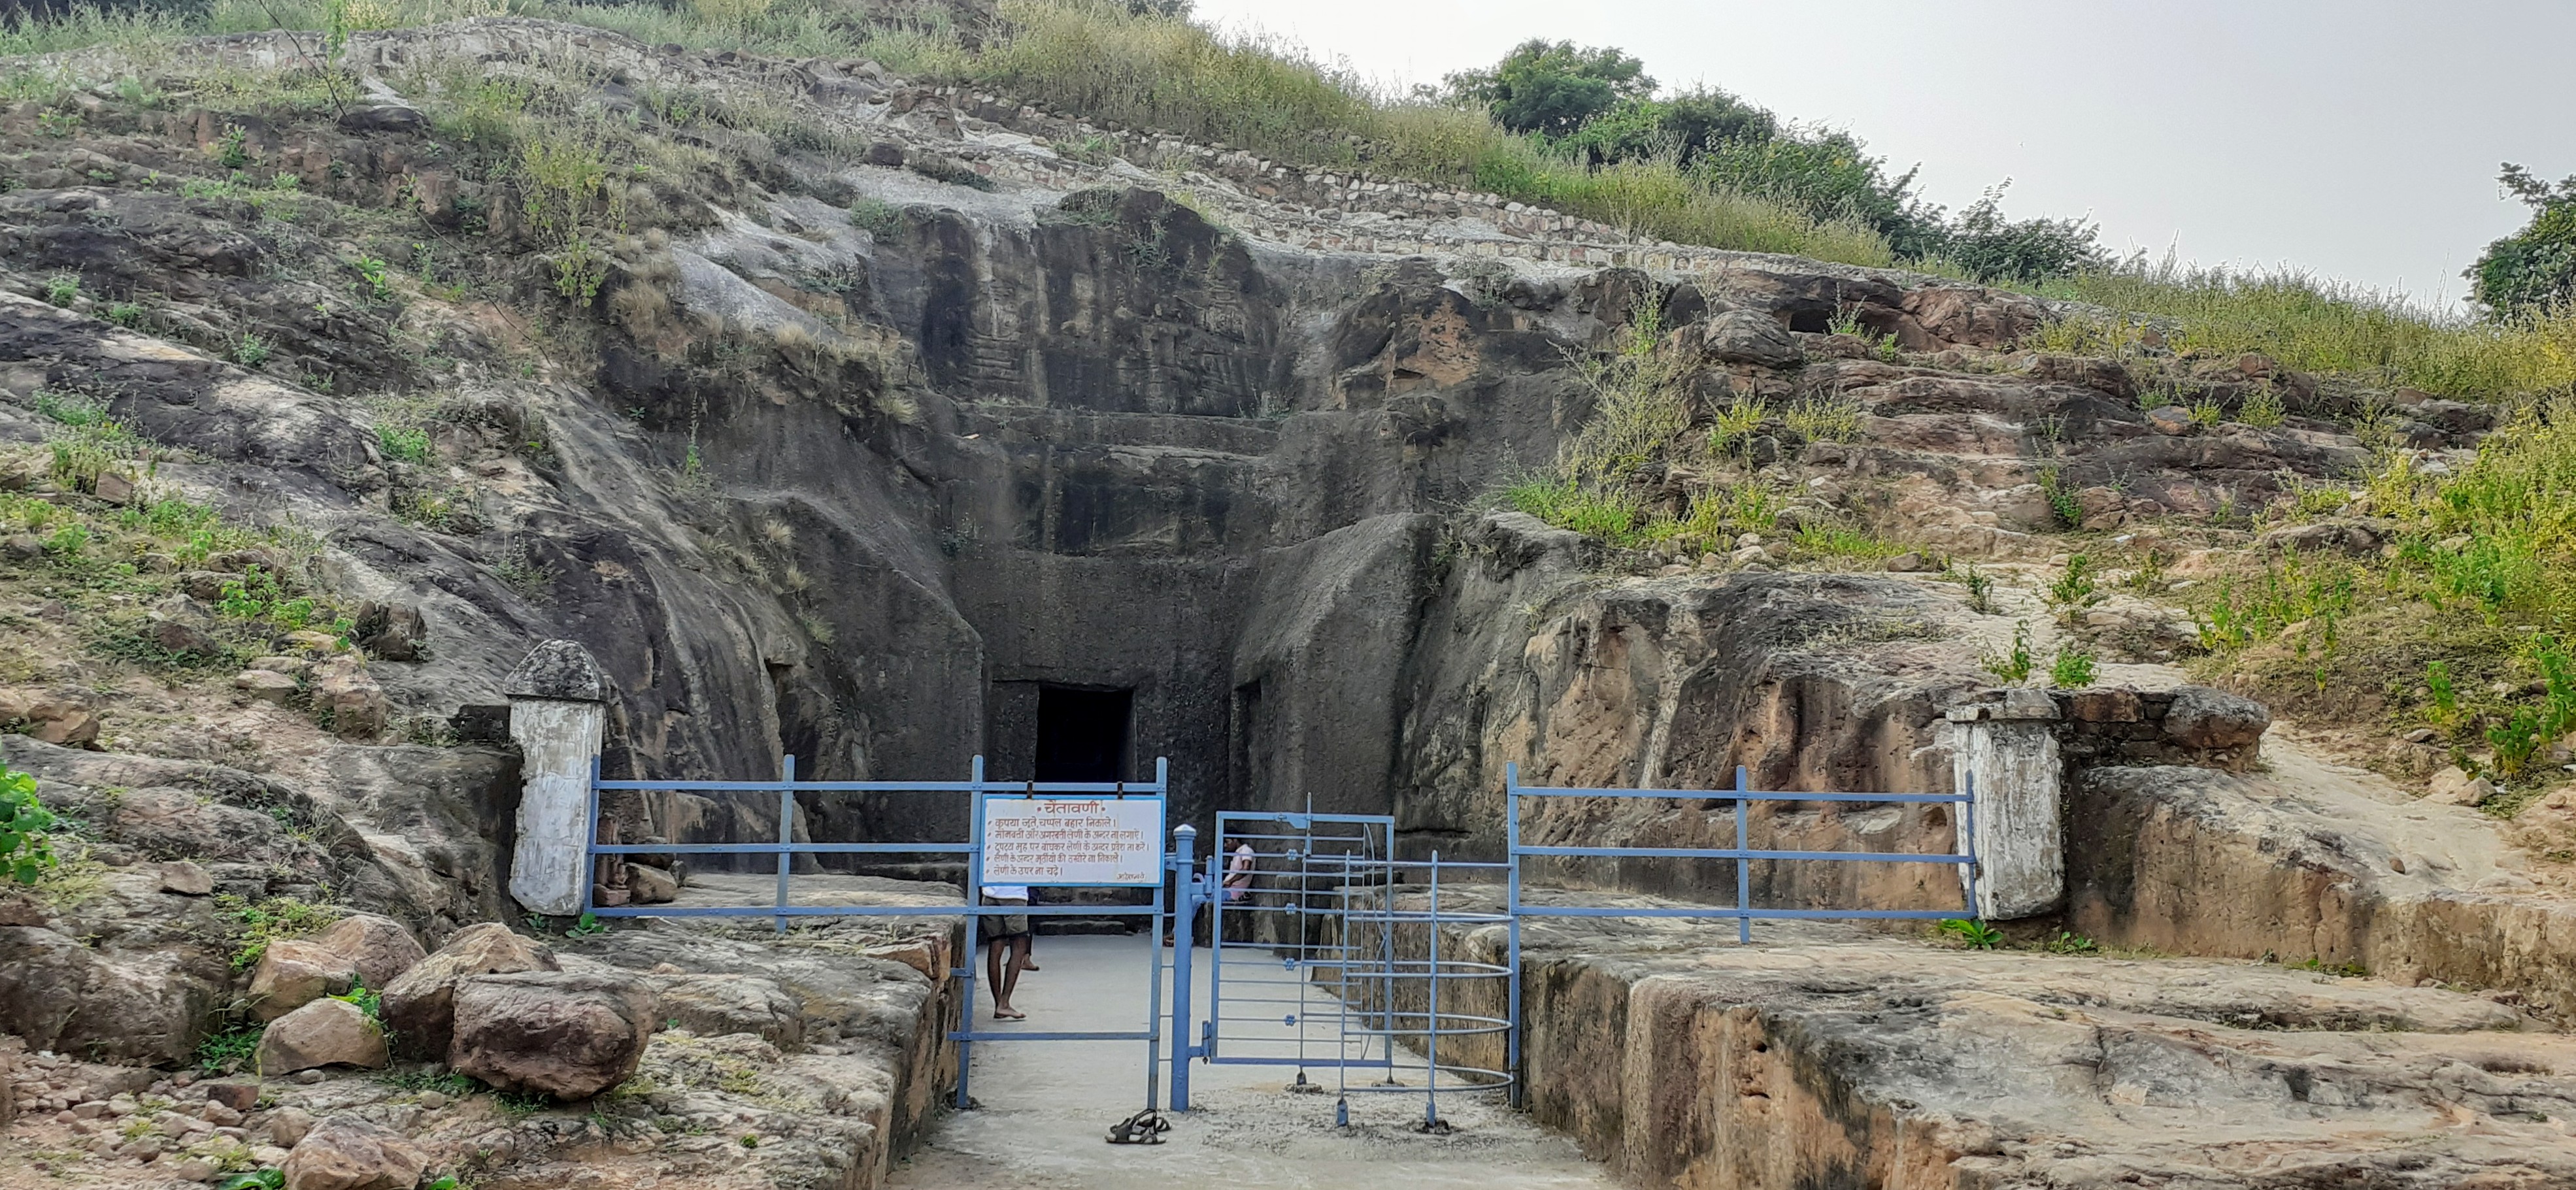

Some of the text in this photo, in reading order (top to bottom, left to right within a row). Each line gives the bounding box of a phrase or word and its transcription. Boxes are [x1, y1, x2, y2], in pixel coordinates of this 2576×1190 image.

[995, 818, 1020, 830] कृपया
[1064, 818, 1084, 828] बहार
[1067, 829, 1083, 839] लेणी
[1084, 829, 1091, 839] के
[1092, 831, 1110, 840] अन्दर
[1111, 831, 1118, 839] ना
[1029, 842, 1040, 851] पर
[1066, 840, 1082, 851] लेणी
[1083, 840, 1090, 851] के
[1092, 843, 1110, 851] अन्दर
[994, 852, 1009, 863] लेणी
[1009, 852, 1016, 862] के
[1057, 853, 1066, 863] की
[994, 865, 1009, 876] लेणी
[1010, 864, 1017, 874] के
